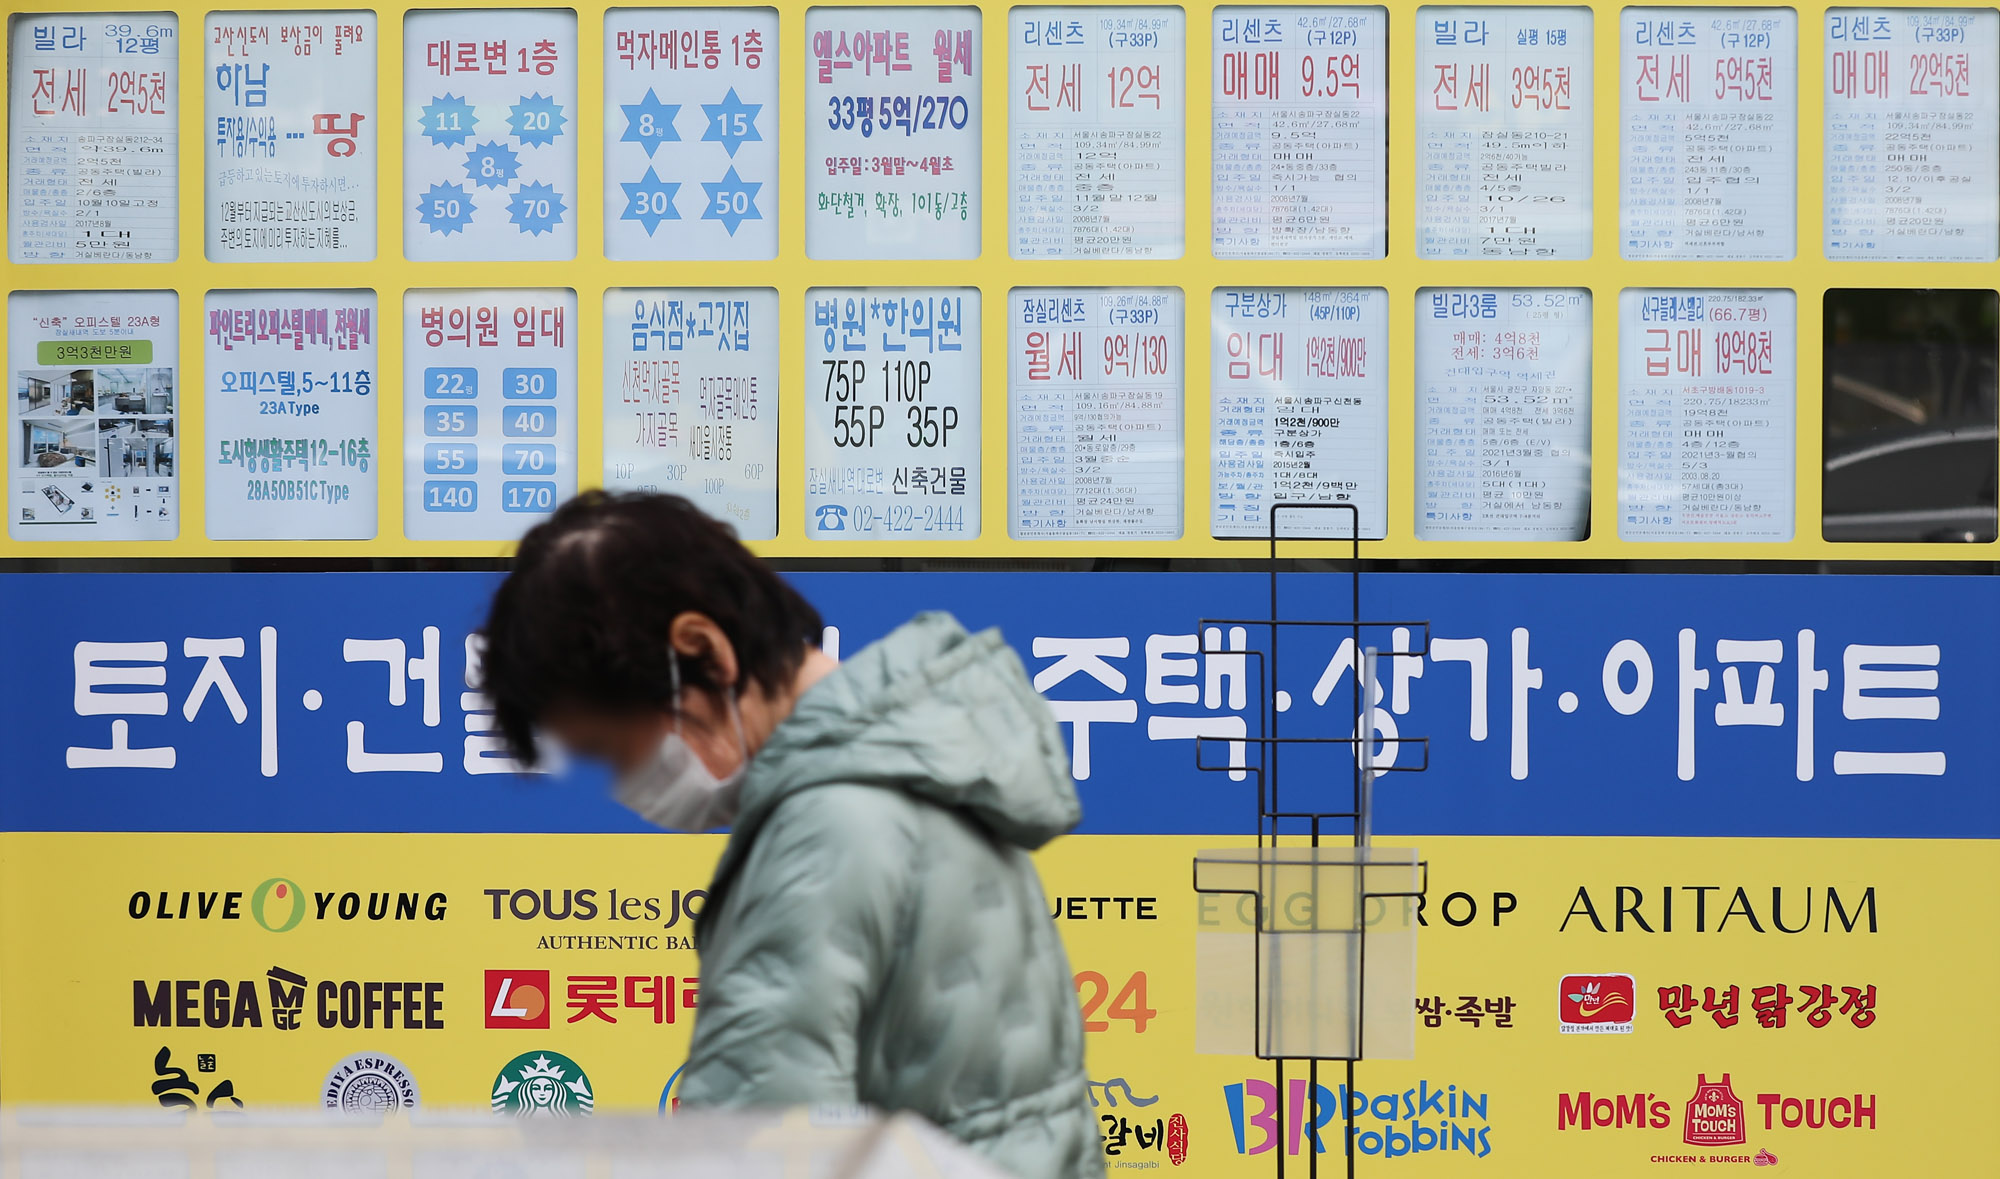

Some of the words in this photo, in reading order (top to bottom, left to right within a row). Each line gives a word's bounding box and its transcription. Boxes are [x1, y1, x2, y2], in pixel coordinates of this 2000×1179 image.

[214, 26, 269, 57] 교산신도시
[281, 26, 323, 56] 보상금이
[335, 25, 363, 55] 풀려요
[1024, 21, 1084, 46] 리센츠
[1108, 32, 1158, 49] (구33P)
[1222, 19, 1282, 43] 리센츠
[1307, 31, 1357, 46] (구12P)
[1516, 28, 1539, 46] 실평
[1546, 28, 1567, 46] 15평
[1636, 21, 1696, 46] 리센츠
[1721, 34, 1770, 49] (구12P)
[1831, 16, 1892, 41] 리센츠
[1915, 27, 1965, 43] (구33P)
[116, 38, 159, 54] 12평
[427, 39, 507, 76] 대로변
[517, 39, 558, 76] 1층
[616, 30, 721, 70] 먹자메인통
[731, 30, 764, 70] 1층
[813, 30, 912, 83] 엘스아파트
[933, 29, 972, 83] 월세
[216, 63, 270, 107] 하남
[1025, 63, 1082, 112] 전세
[1108, 65, 1160, 110] 12억
[1223, 51, 1279, 100] 매매
[1302, 54, 1359, 99] 9.5억
[1433, 63, 1490, 112] 전세
[1511, 65, 1571, 111] 3억5천
[1636, 54, 1690, 103] 전세
[1715, 56, 1773, 102] 5억5천
[1832, 50, 1889, 99] 매매
[1910, 52, 1970, 98] 22억5천
[108, 71, 166, 115] 2억5천
[436, 112, 462, 131] 11
[523, 111, 550, 131] 20
[717, 114, 747, 136] 15
[828, 96, 873, 138] 33평
[879, 95, 969, 136] 5억/270
[217, 116, 277, 158] 투자용/수익용
[312, 113, 365, 158] 땅
[433, 200, 460, 218] 50
[523, 200, 550, 218] 70
[634, 191, 667, 214] 30
[715, 191, 748, 214] 50
[1023, 299, 1085, 324] 잠실리센츠
[1109, 309, 1159, 325] (구33P)
[1225, 293, 1287, 318] 구분상가
[1310, 305, 1360, 321] (45P/110P)
[1433, 293, 1497, 319] 빌라3룸
[1709, 307, 1767, 322] (66.7평)
[74, 316, 121, 328] 오피스텔
[127, 315, 160, 327] 23A형
[421, 306, 498, 348] 병의원
[513, 306, 564, 348] 임대
[1494, 331, 1540, 345] 4억8천
[1644, 328, 1701, 376] 급매
[1715, 330, 1772, 375] 19억8천
[56, 345, 132, 360] 3억3천만원
[1025, 331, 1082, 381] 월세
[1104, 332, 1168, 379] 9억/130
[1227, 332, 1283, 380] 임대
[1306, 335, 1367, 379] 1억2천/900만
[515, 375, 544, 395] 30
[822, 360, 865, 402] 75P
[882, 360, 931, 402] 110P
[436, 412, 465, 432] 35
[515, 412, 544, 432] 40
[834, 406, 884, 447] 55P
[907, 406, 958, 447] 35P
[689, 425, 732, 461] 새마을시장통
[436, 450, 465, 470] 55
[515, 450, 544, 470] 70
[615, 463, 635, 479] 10P
[667, 464, 687, 480] 30P
[744, 464, 764, 480] 60P
[704, 478, 724, 494] 100P
[892, 467, 966, 495] 신축건물
[429, 487, 473, 507] 140
[508, 488, 551, 508] 170
[853, 505, 964, 532] 02-422-2444
[128, 891, 243, 920] OLIVE
[315, 891, 448, 922] YOUNG
[483, 888, 598, 922] TOUS
[608, 887, 662, 922] les
[664, 888, 706, 928] JO
[1558, 885, 1879, 934] ARITAUM
[536, 936, 658, 951] AUTHENTIC
[132, 979, 263, 1030] MEGA
[317, 980, 445, 1030] COFFEE
[1074, 970, 1157, 1034] 24
[326, 1065, 354, 1108] EDIYA
[354, 1058, 414, 1108] ESPRESSO
[1692, 1119, 1736, 1132] TOUCH
[1757, 1094, 1876, 1130] TOUCH
[1115, 1162, 1160, 1170] Jinsagalbi
